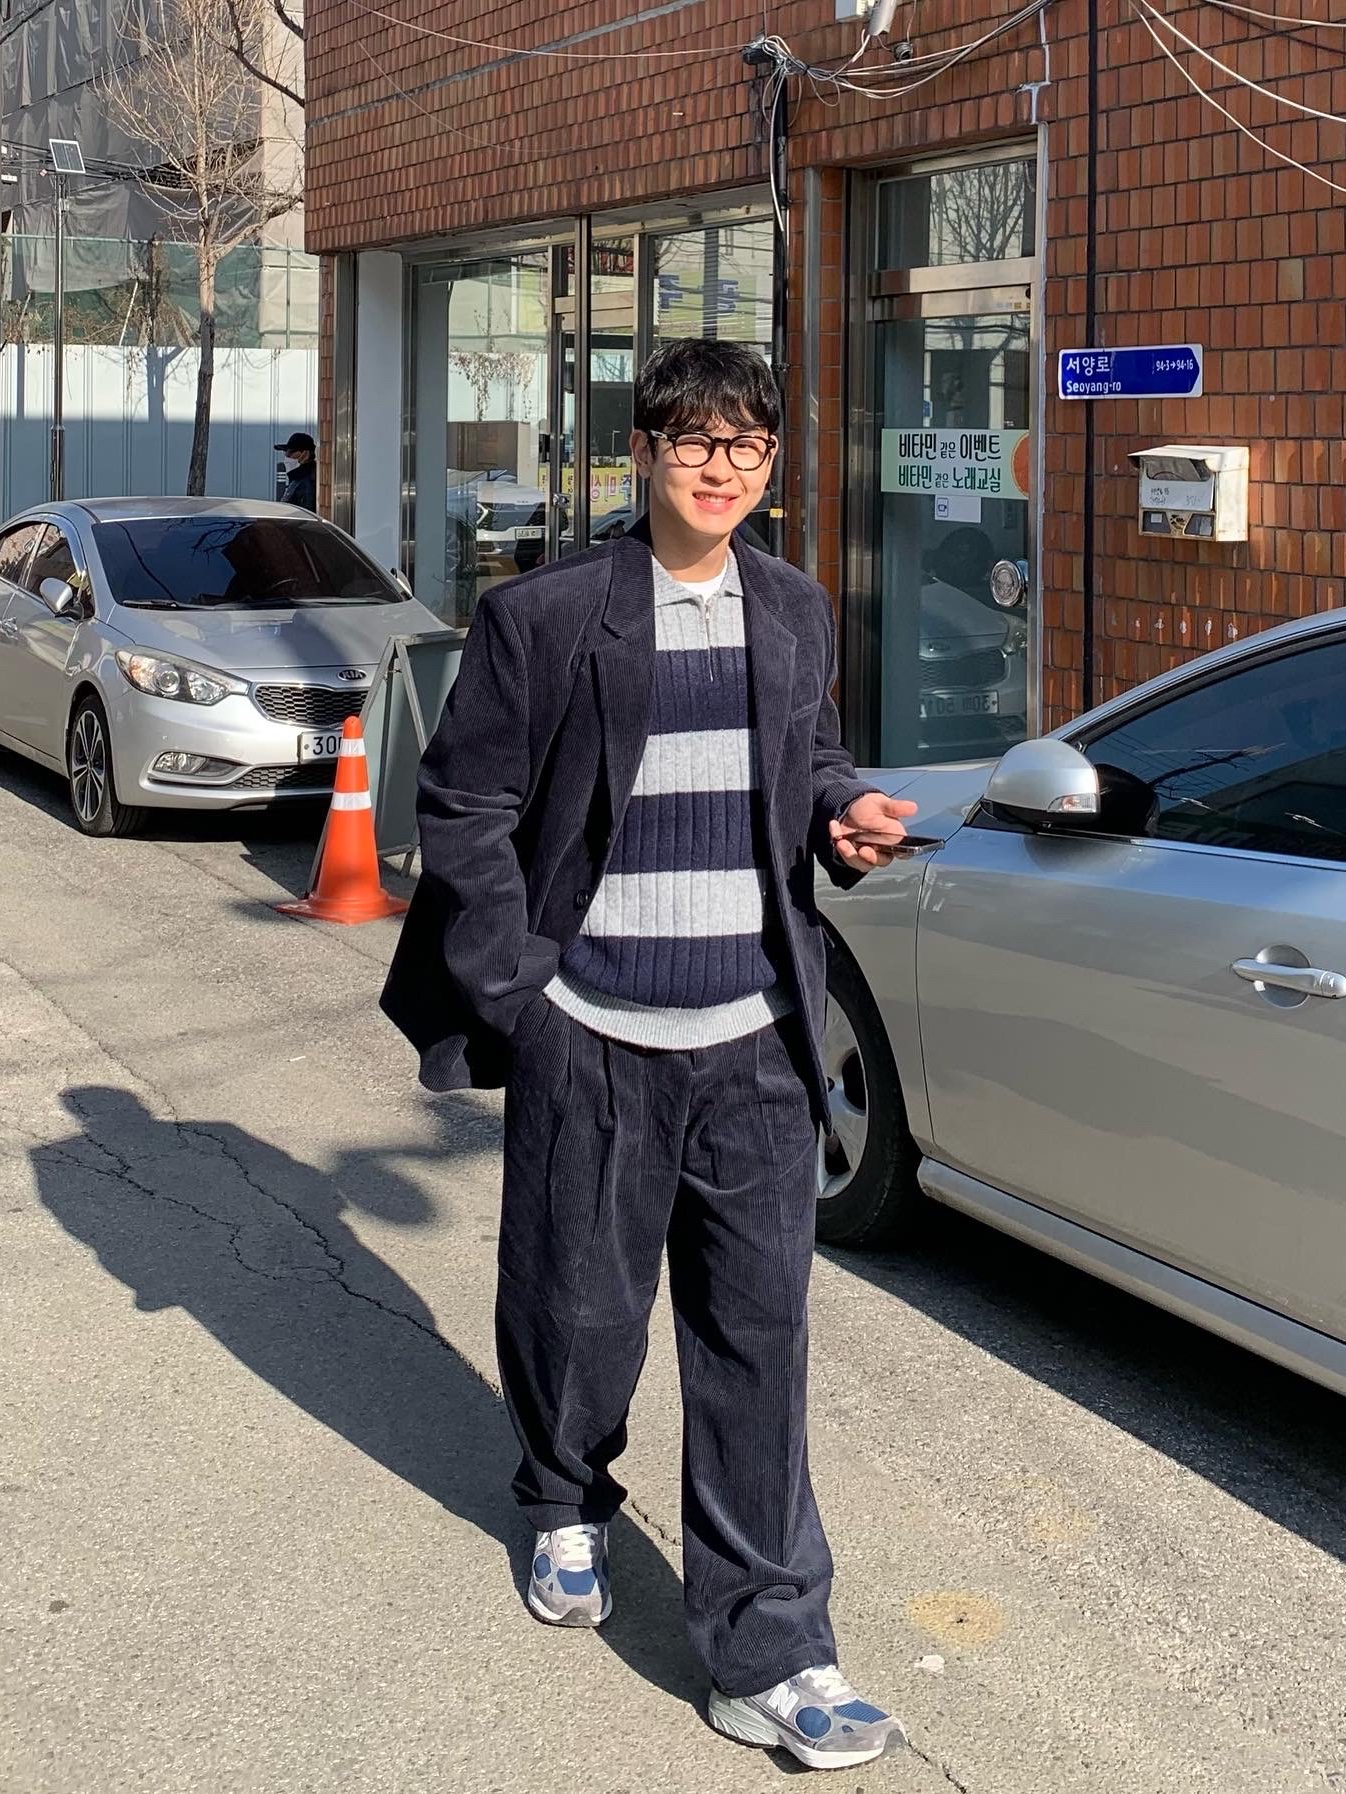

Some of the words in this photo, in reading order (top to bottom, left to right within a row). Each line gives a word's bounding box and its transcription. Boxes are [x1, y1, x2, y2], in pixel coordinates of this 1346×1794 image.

[1066, 356, 1110, 377] 서양로
[1066, 381, 1121, 394] Seoyang-ro
[898, 433, 937, 460] 비타민
[940, 442, 956, 459] 같은
[960, 434, 1002, 462] 이벤트
[898, 465, 932, 489] 비타민
[934, 473, 950, 489] 같은
[951, 466, 1001, 493] 노래교실
